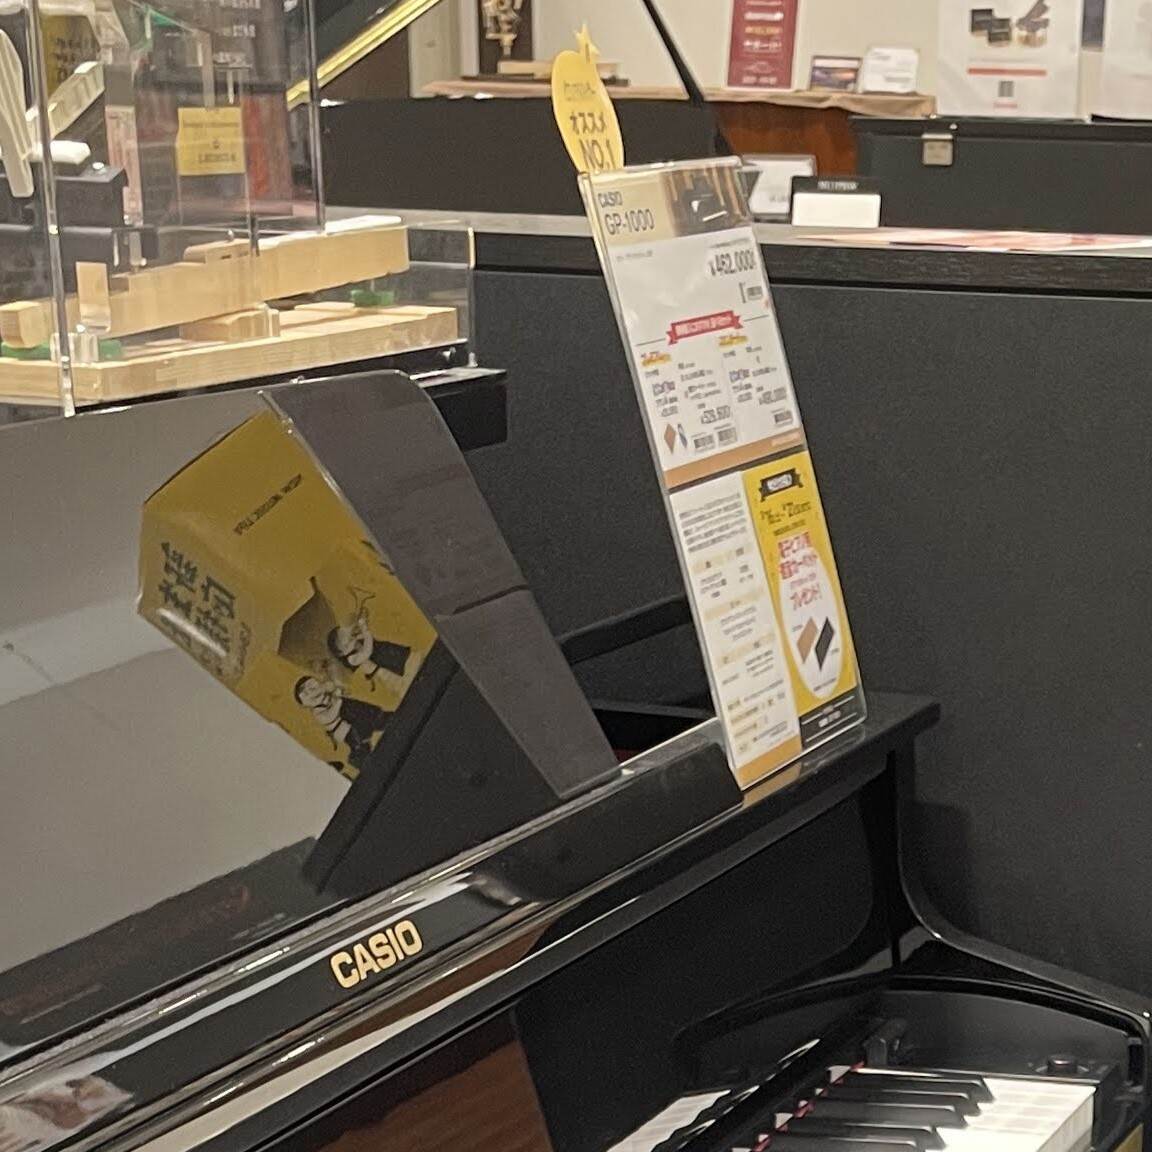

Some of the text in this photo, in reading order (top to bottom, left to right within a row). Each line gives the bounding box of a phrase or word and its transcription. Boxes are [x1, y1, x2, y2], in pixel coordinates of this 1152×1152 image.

[598, 191, 623, 208] CASIO
[605, 208, 655, 235] GP-1000
[330, 920, 423, 988] CASIO
